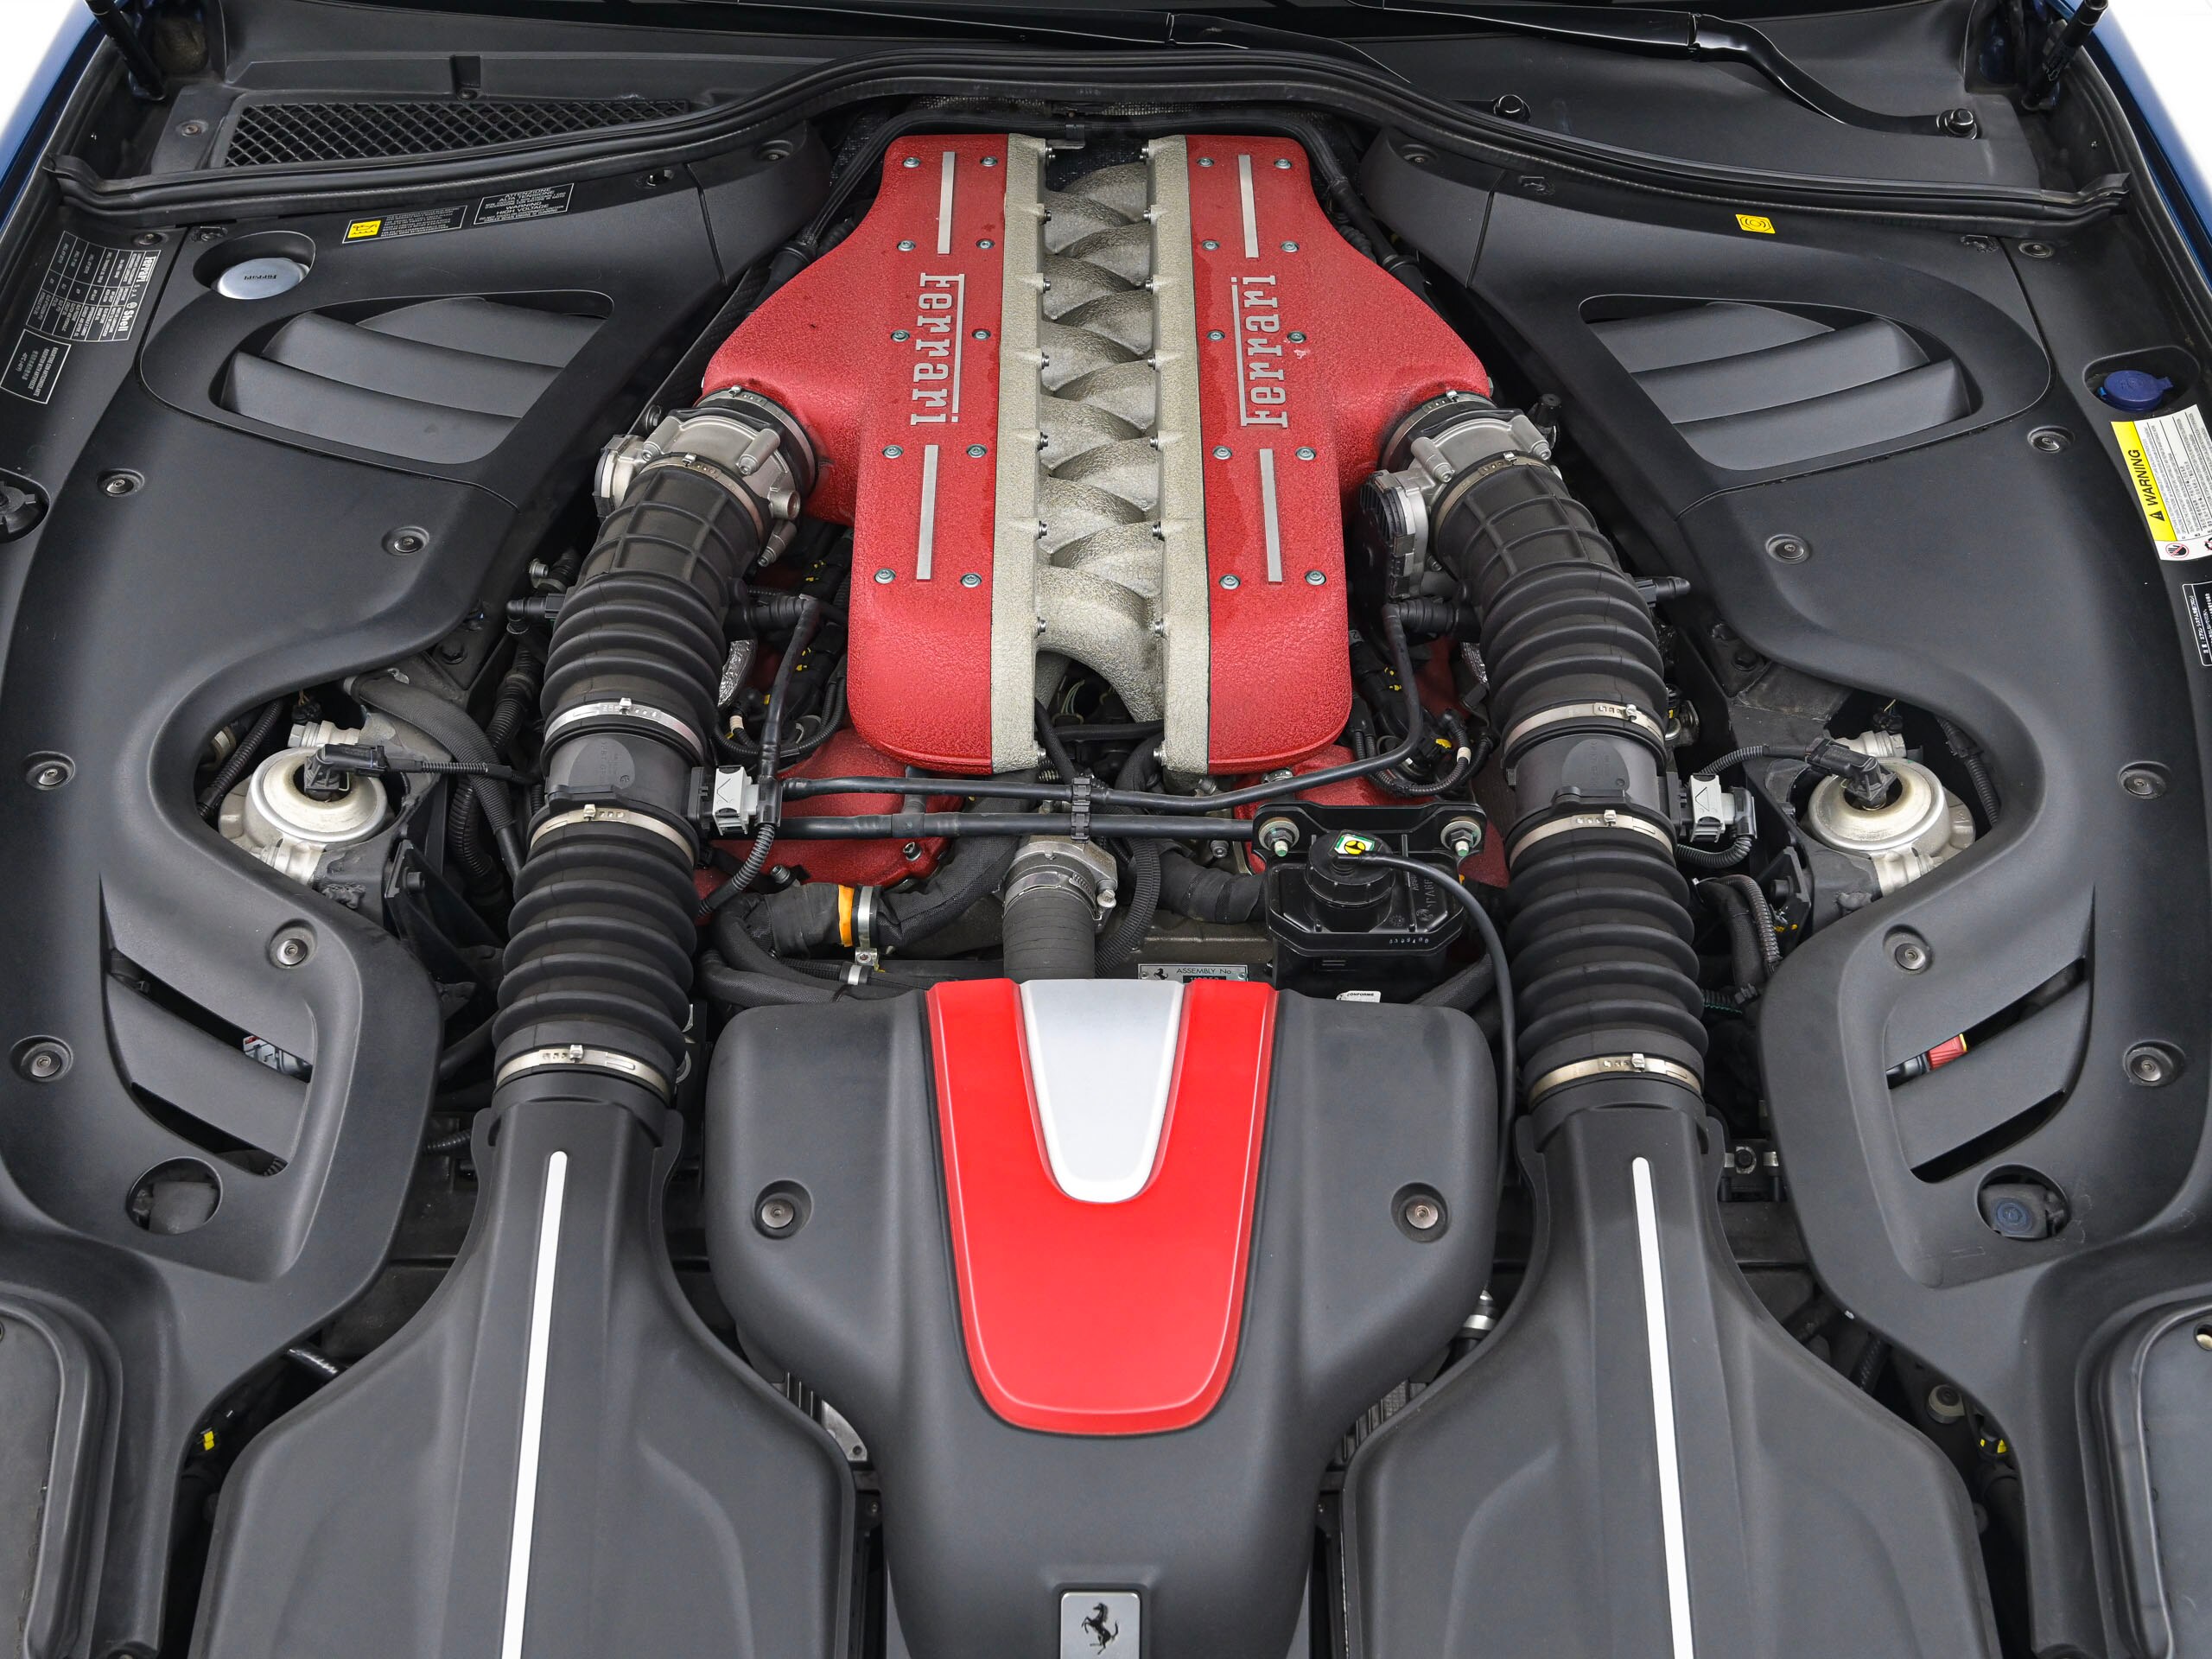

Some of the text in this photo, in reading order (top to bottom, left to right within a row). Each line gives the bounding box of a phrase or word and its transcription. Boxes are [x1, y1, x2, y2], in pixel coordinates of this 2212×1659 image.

[516, 203, 550, 212] VOLTAGE
[137, 256, 156, 283] Ferrari
[118, 309, 135, 332] Shell
[910, 272, 965, 425] Ferrari
[1231, 275, 1287, 429] Ferrari
[2128, 449, 2158, 506] WARNING
